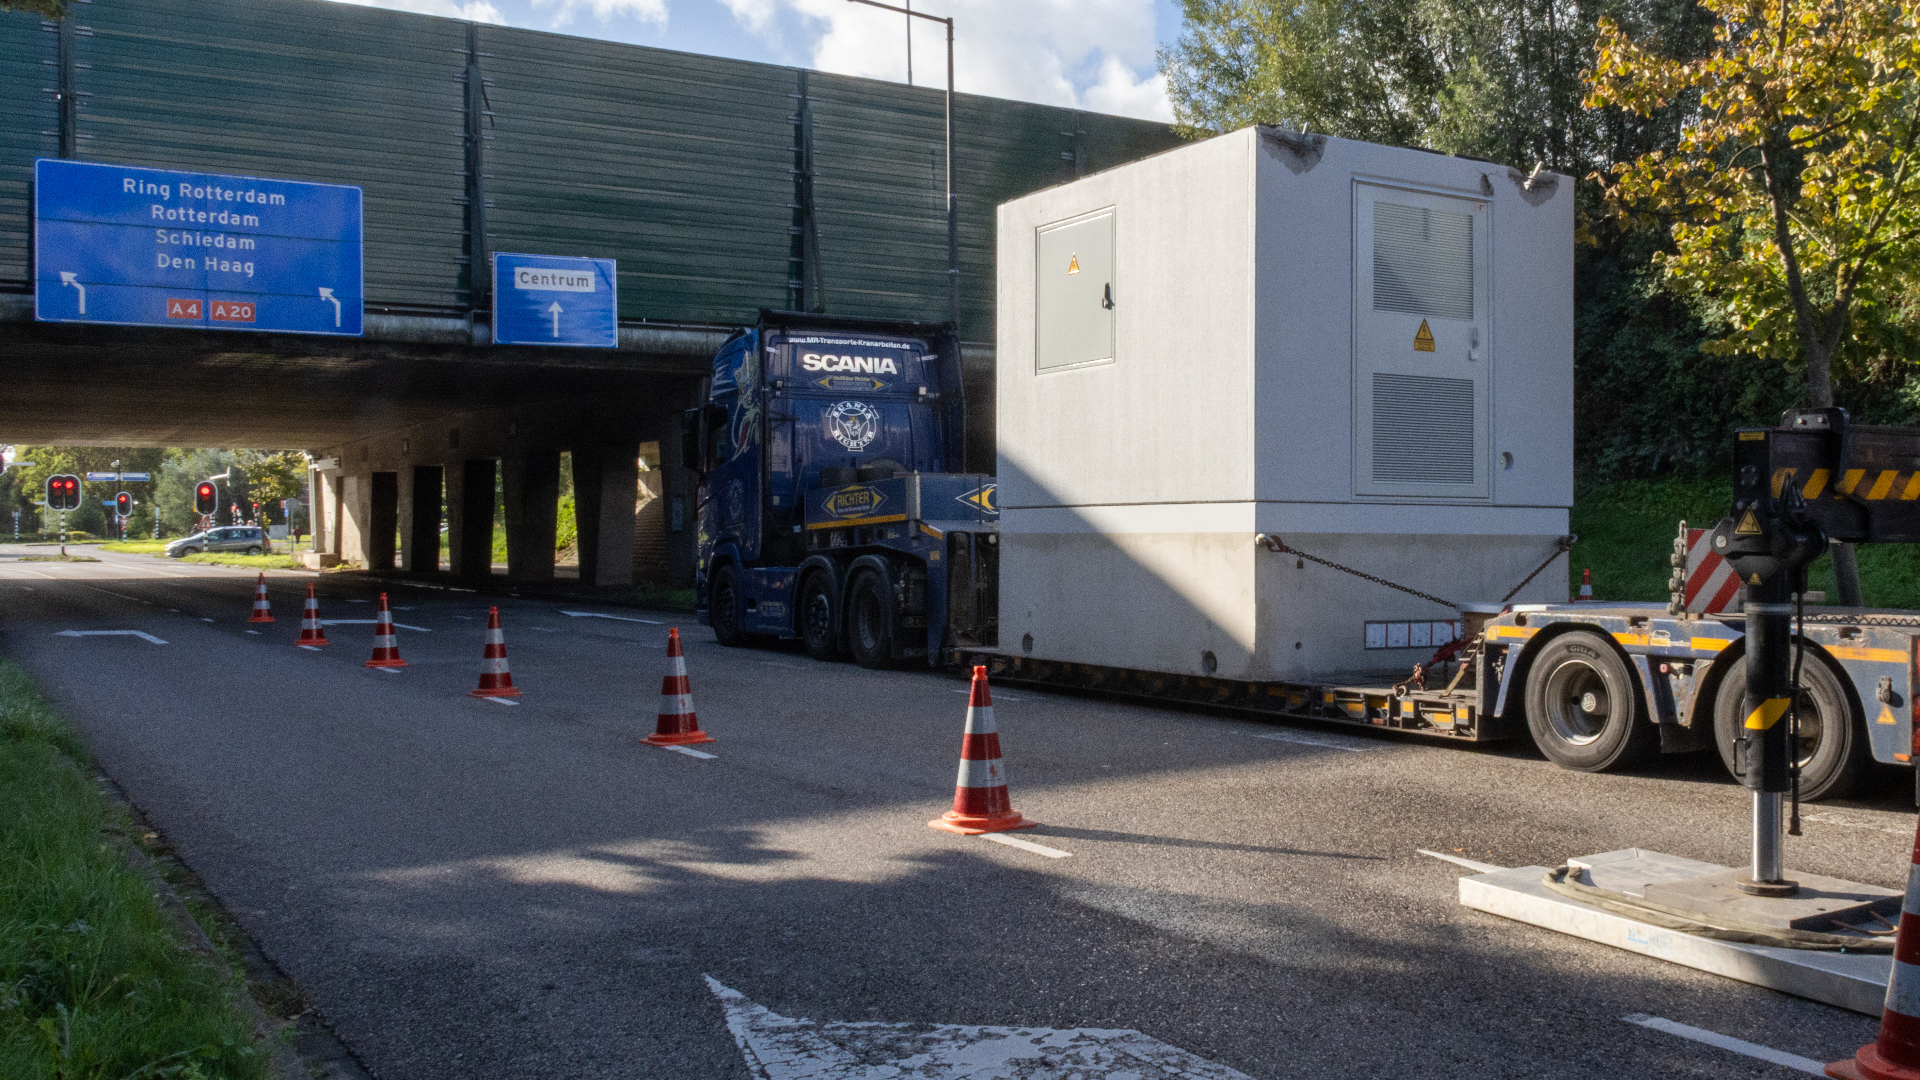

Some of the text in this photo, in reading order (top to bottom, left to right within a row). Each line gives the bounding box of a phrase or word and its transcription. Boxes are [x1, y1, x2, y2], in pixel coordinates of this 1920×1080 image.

[123, 178, 286, 206] Ring Rotterdam
[151, 204, 259, 227] Rotterdam
[156, 229, 255, 250] Schiedam
[157, 253, 254, 277] Den Haag
[520, 271, 590, 288] Centrum
[789, 336, 911, 350] www.MR-Transporte-Kranarbeiten.de
[802, 353, 898, 375] SCANIA
[832, 402, 872, 419] SCANIA
[837, 491, 870, 507] RICHTER
